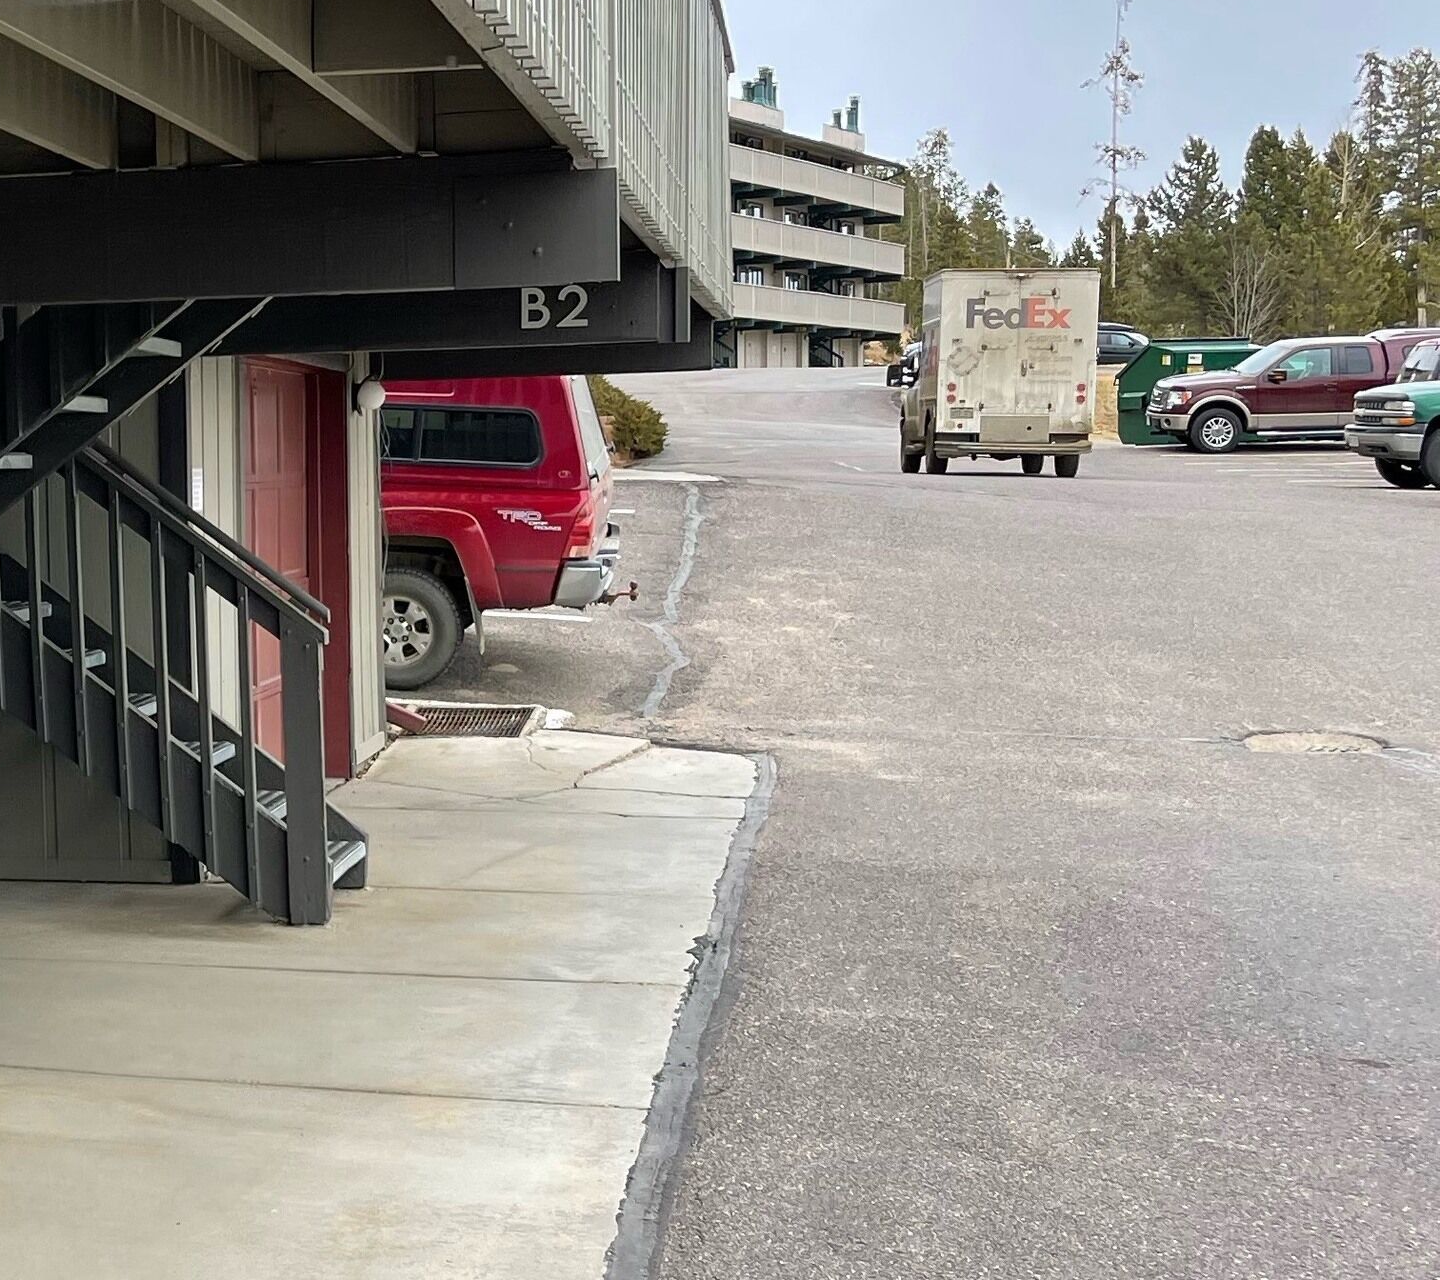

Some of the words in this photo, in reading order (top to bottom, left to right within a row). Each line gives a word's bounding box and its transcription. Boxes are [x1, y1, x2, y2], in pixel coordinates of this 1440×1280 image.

[520, 284, 589, 329] B2
[965, 295, 1072, 329] FedEx
[497, 509, 542, 524] TRD
